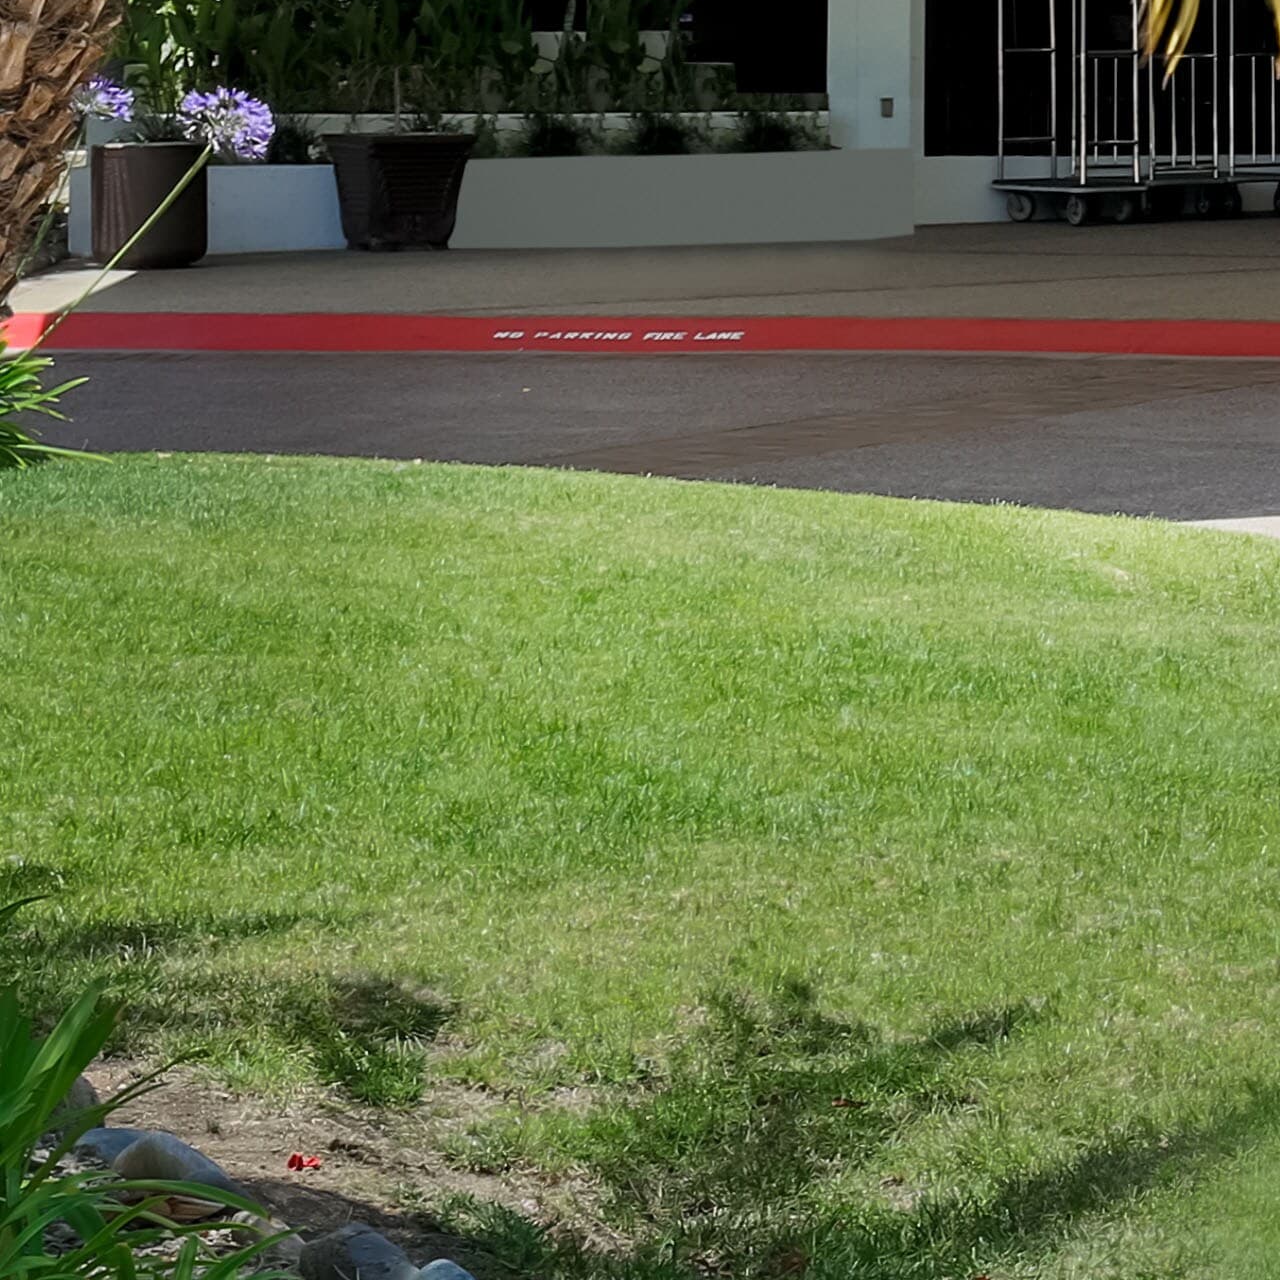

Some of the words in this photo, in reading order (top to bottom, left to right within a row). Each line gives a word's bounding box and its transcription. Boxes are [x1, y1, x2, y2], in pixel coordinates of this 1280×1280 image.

[492, 330, 525, 340] NO
[533, 330, 633, 341] PARKING
[641, 330, 689, 341] FIRE
[693, 330, 746, 341] LANE
